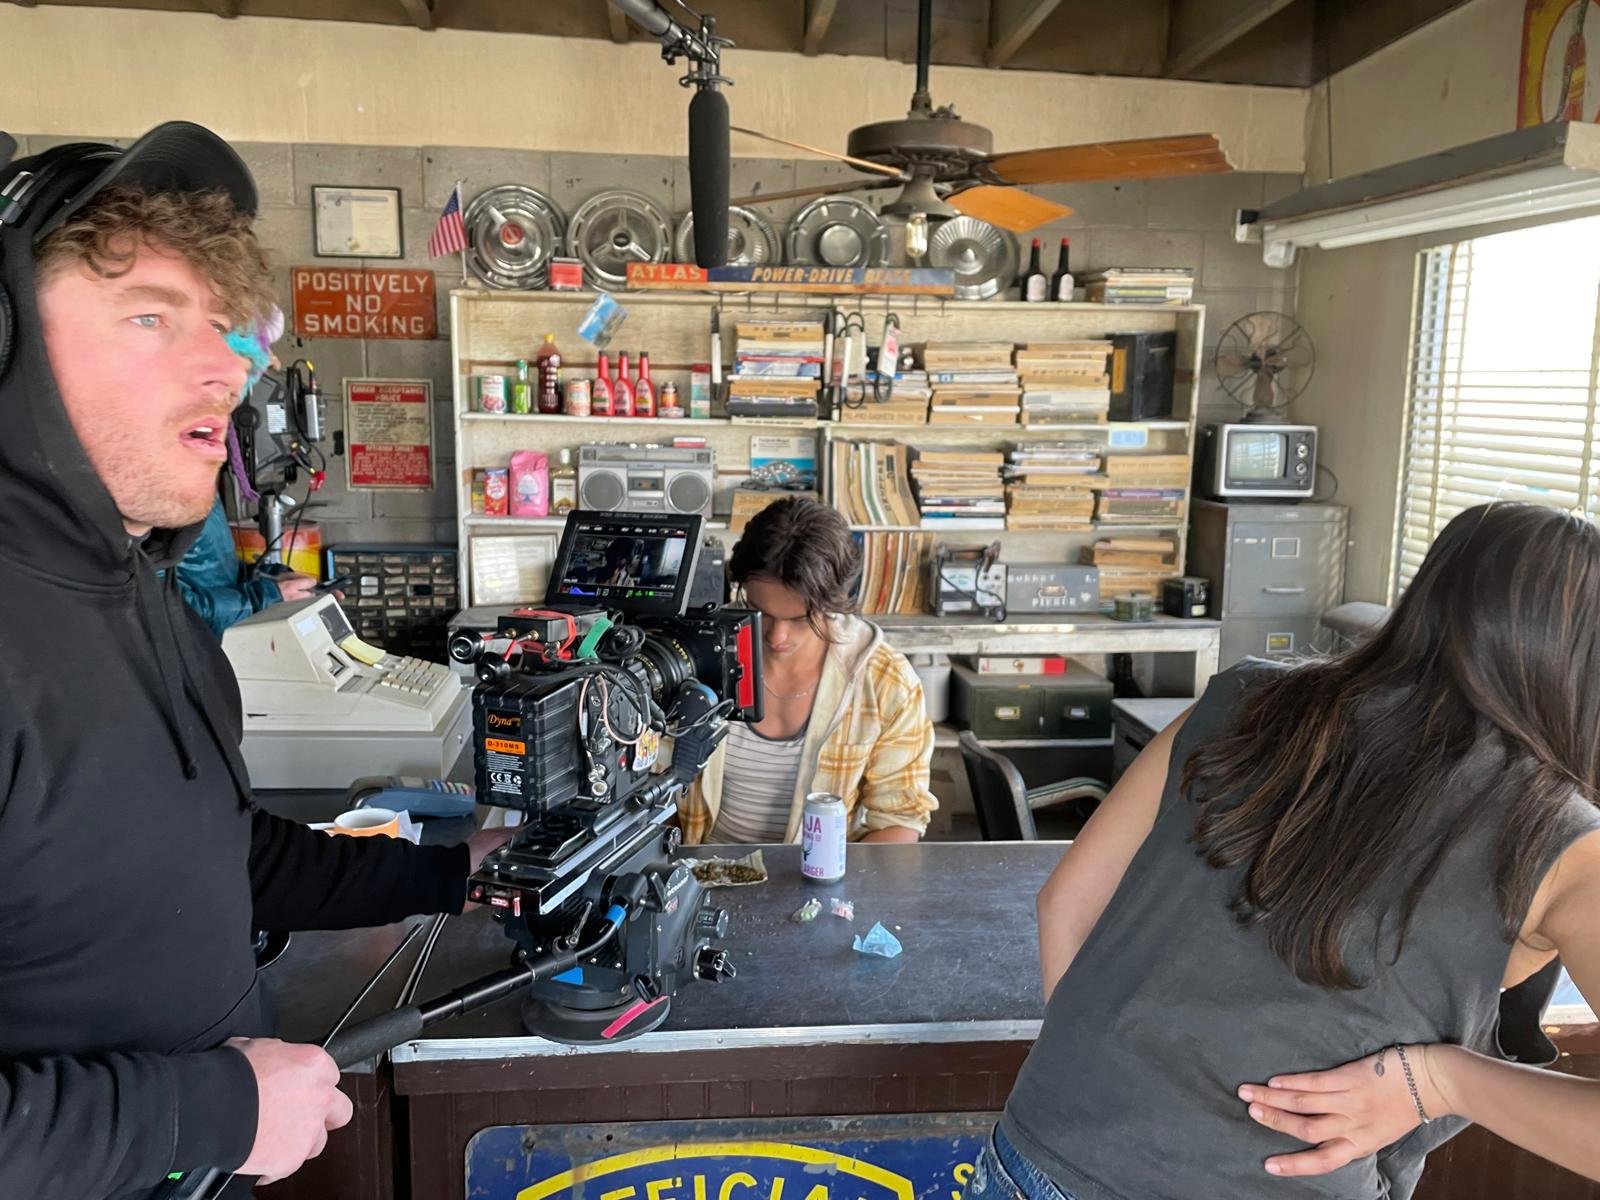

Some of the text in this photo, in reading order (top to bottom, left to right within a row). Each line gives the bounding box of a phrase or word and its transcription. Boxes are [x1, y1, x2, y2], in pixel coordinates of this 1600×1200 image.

[297, 272, 428, 293] POSITIVELY
[631, 264, 701, 280] ATLAS
[751, 266, 854, 283] POWER-DRIVE
[346, 294, 381, 313] NO
[305, 314, 424, 334] SMOKING
[803, 815, 822, 833] JA
